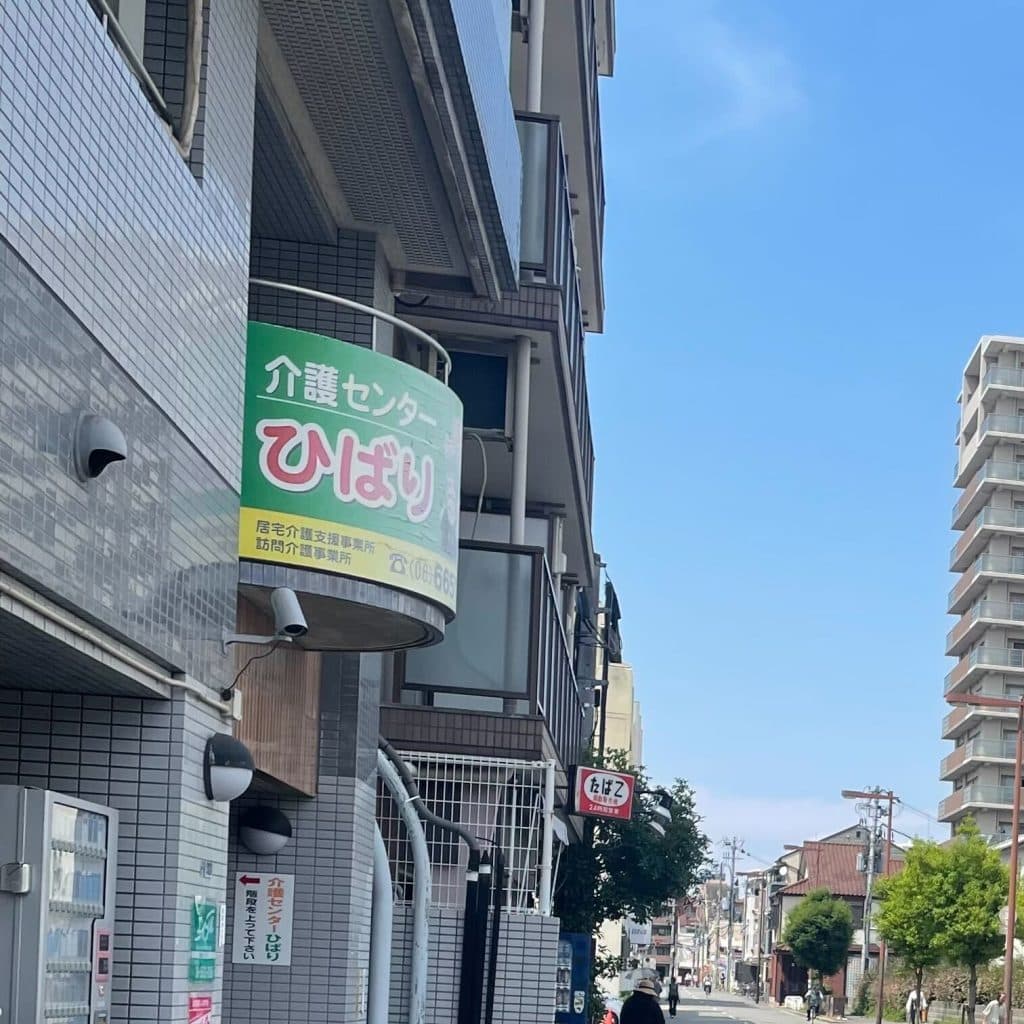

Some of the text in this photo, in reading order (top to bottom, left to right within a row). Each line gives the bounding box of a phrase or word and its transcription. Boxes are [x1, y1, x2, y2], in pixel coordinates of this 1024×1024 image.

[264, 354, 437, 426] 介護センター
[257, 420, 433, 521] ひばり
[256, 520, 375, 555] 居宅介護支援事業所
[256, 536, 351, 565] 訪問介護事業所
[590, 776, 624, 798] たばこ
